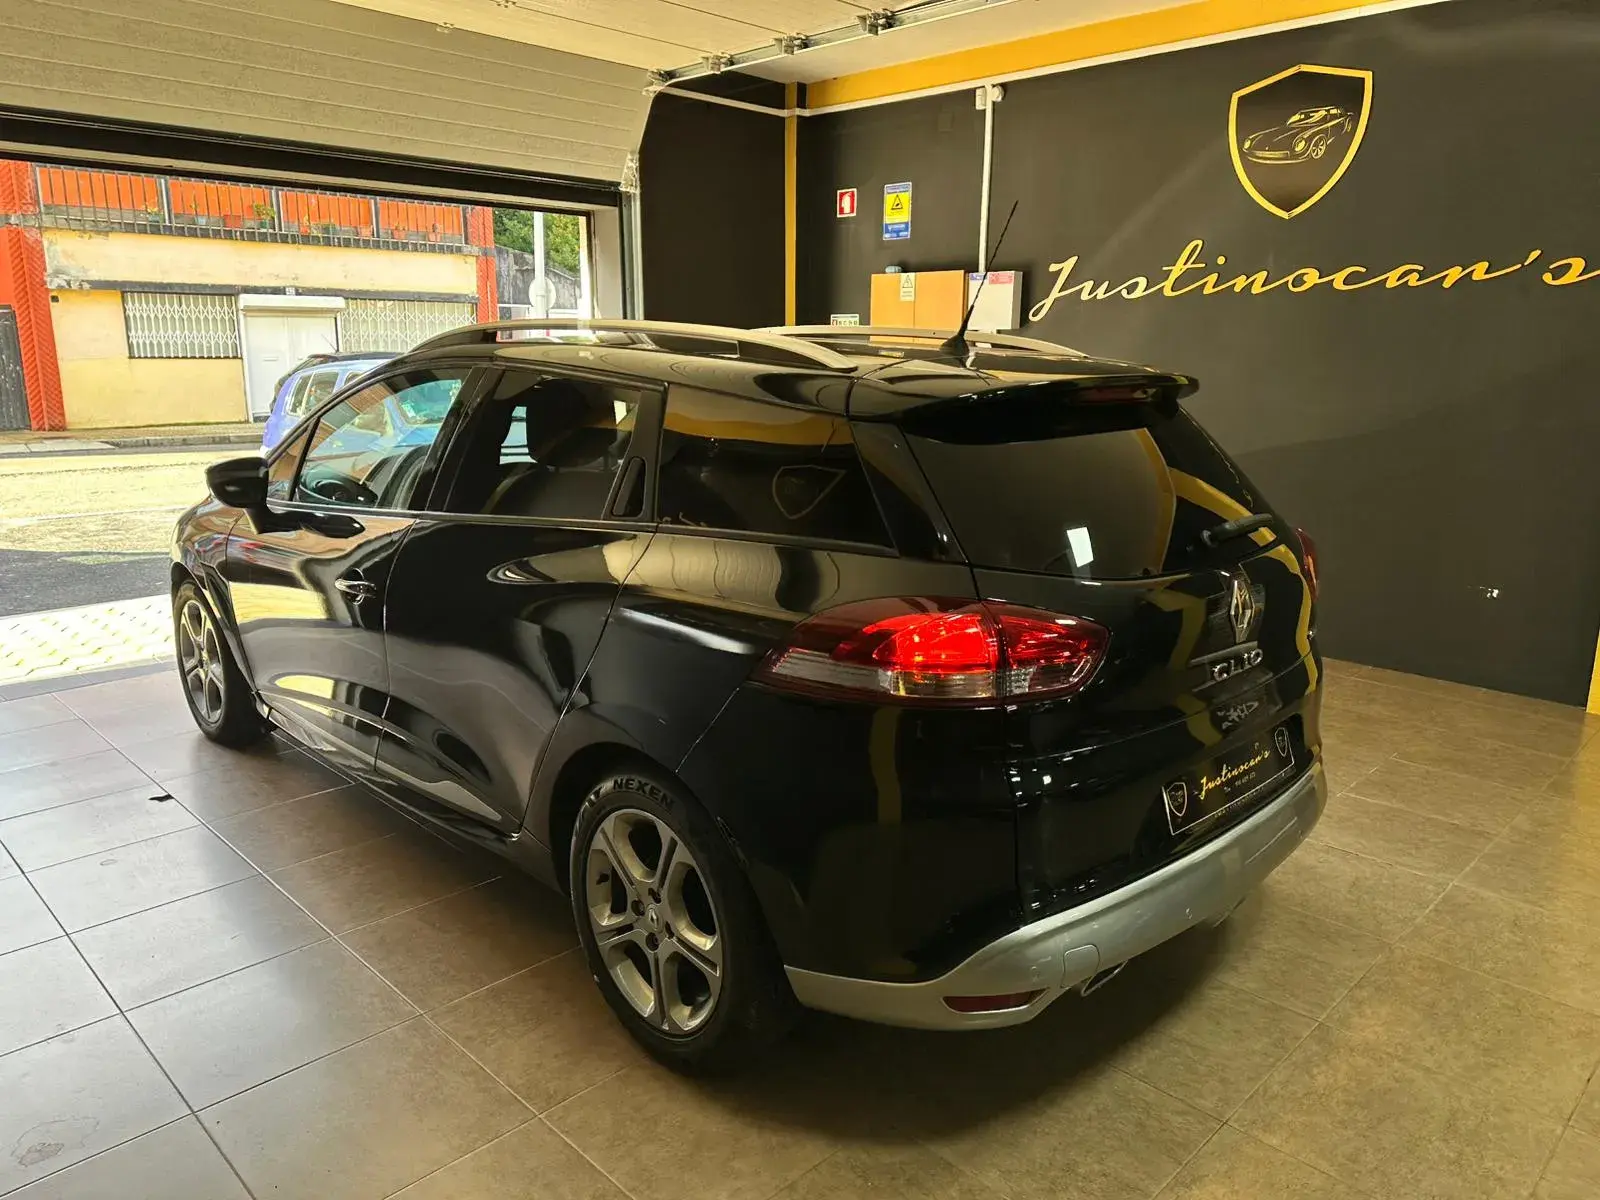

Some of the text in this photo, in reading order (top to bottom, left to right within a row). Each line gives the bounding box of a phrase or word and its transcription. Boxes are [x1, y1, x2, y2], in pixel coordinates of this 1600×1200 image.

[1028, 238, 1600, 322] Justinocan's
[1212, 648, 1264, 681] CLIO
[613, 778, 676, 810] NEXEN
